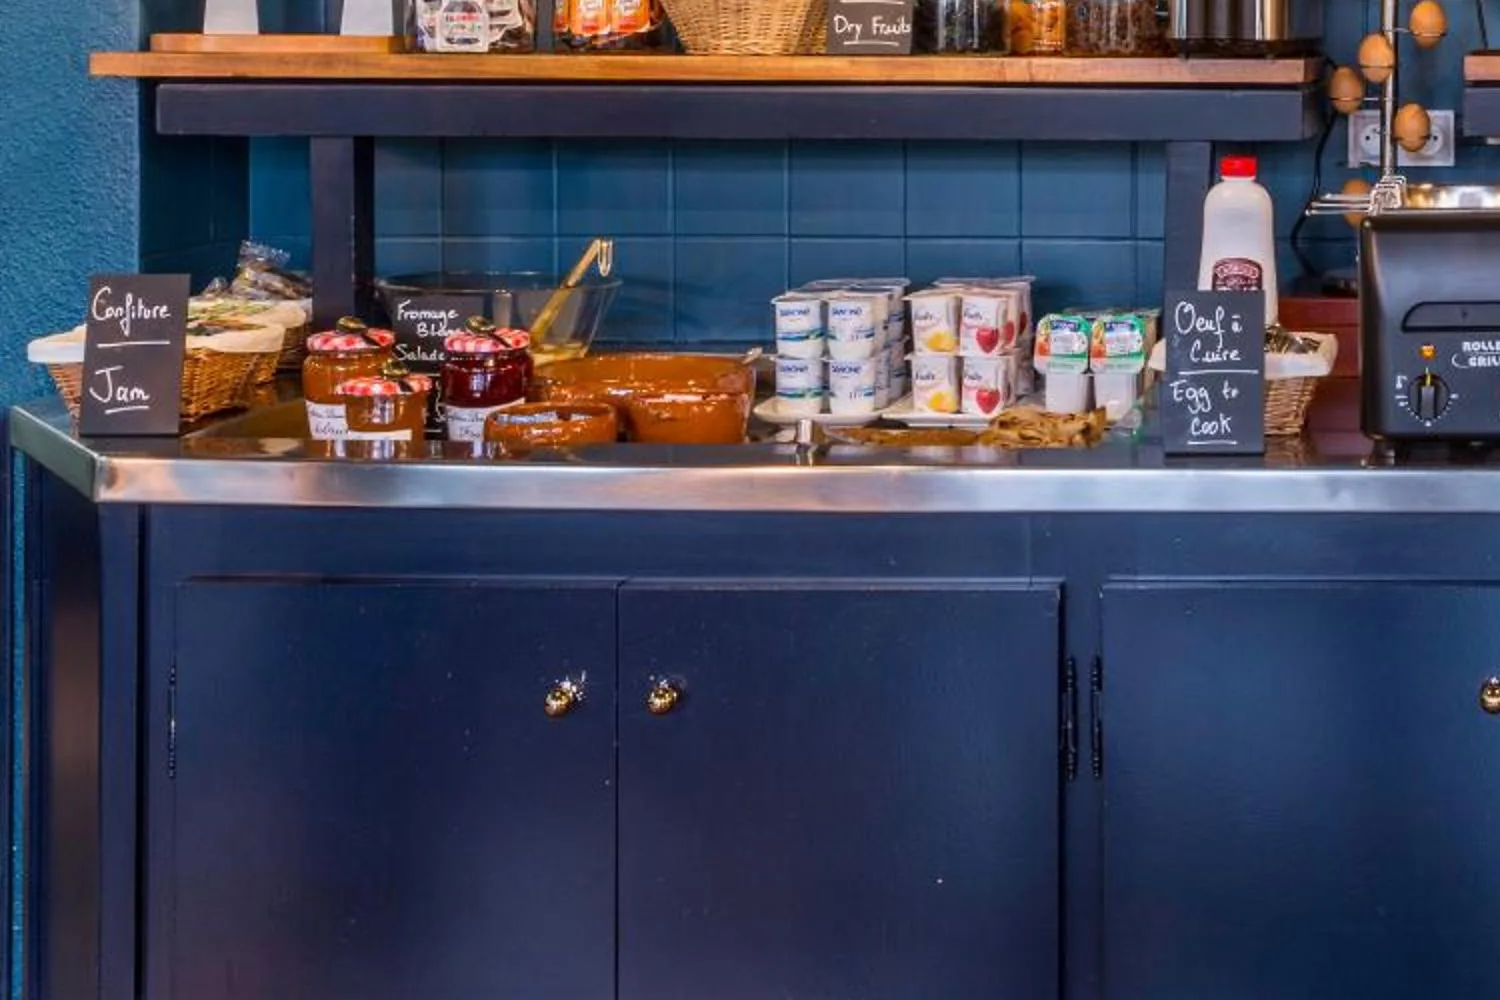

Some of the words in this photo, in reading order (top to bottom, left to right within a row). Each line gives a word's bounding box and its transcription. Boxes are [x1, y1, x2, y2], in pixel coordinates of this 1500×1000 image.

[833, 13, 862, 42] Dry
[871, 15, 911, 35] Fruits
[92, 286, 171, 337] Confiture
[397, 299, 459, 327] Fromage
[1175, 300, 1225, 350] Oeuf
[396, 344, 445, 361] Salade
[1190, 339, 1241, 363] Cuire
[89, 365, 150, 402] Jam
[1168, 379, 1211, 414] Egg
[1222, 379, 1240, 400] to
